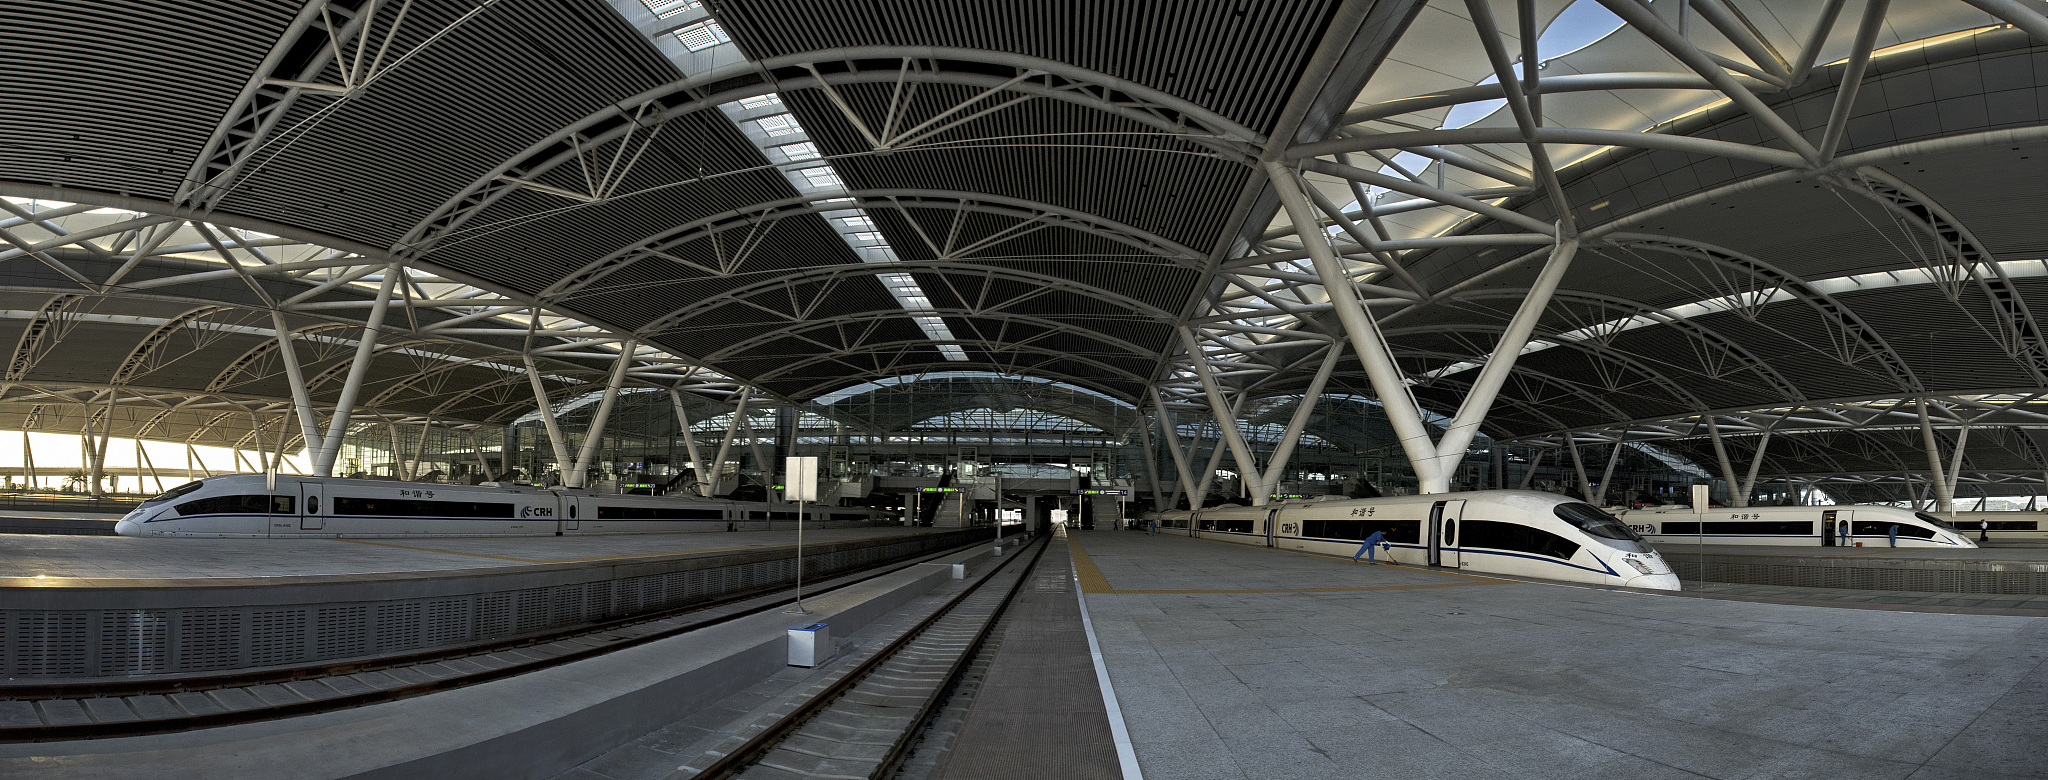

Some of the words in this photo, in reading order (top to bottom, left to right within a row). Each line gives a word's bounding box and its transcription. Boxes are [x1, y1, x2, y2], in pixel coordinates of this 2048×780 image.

[399, 489, 435, 499] 和谐号
[533, 507, 553, 517] CRH
[1350, 506, 1376, 518] 和谐号
[1281, 523, 1293, 534] CRH
